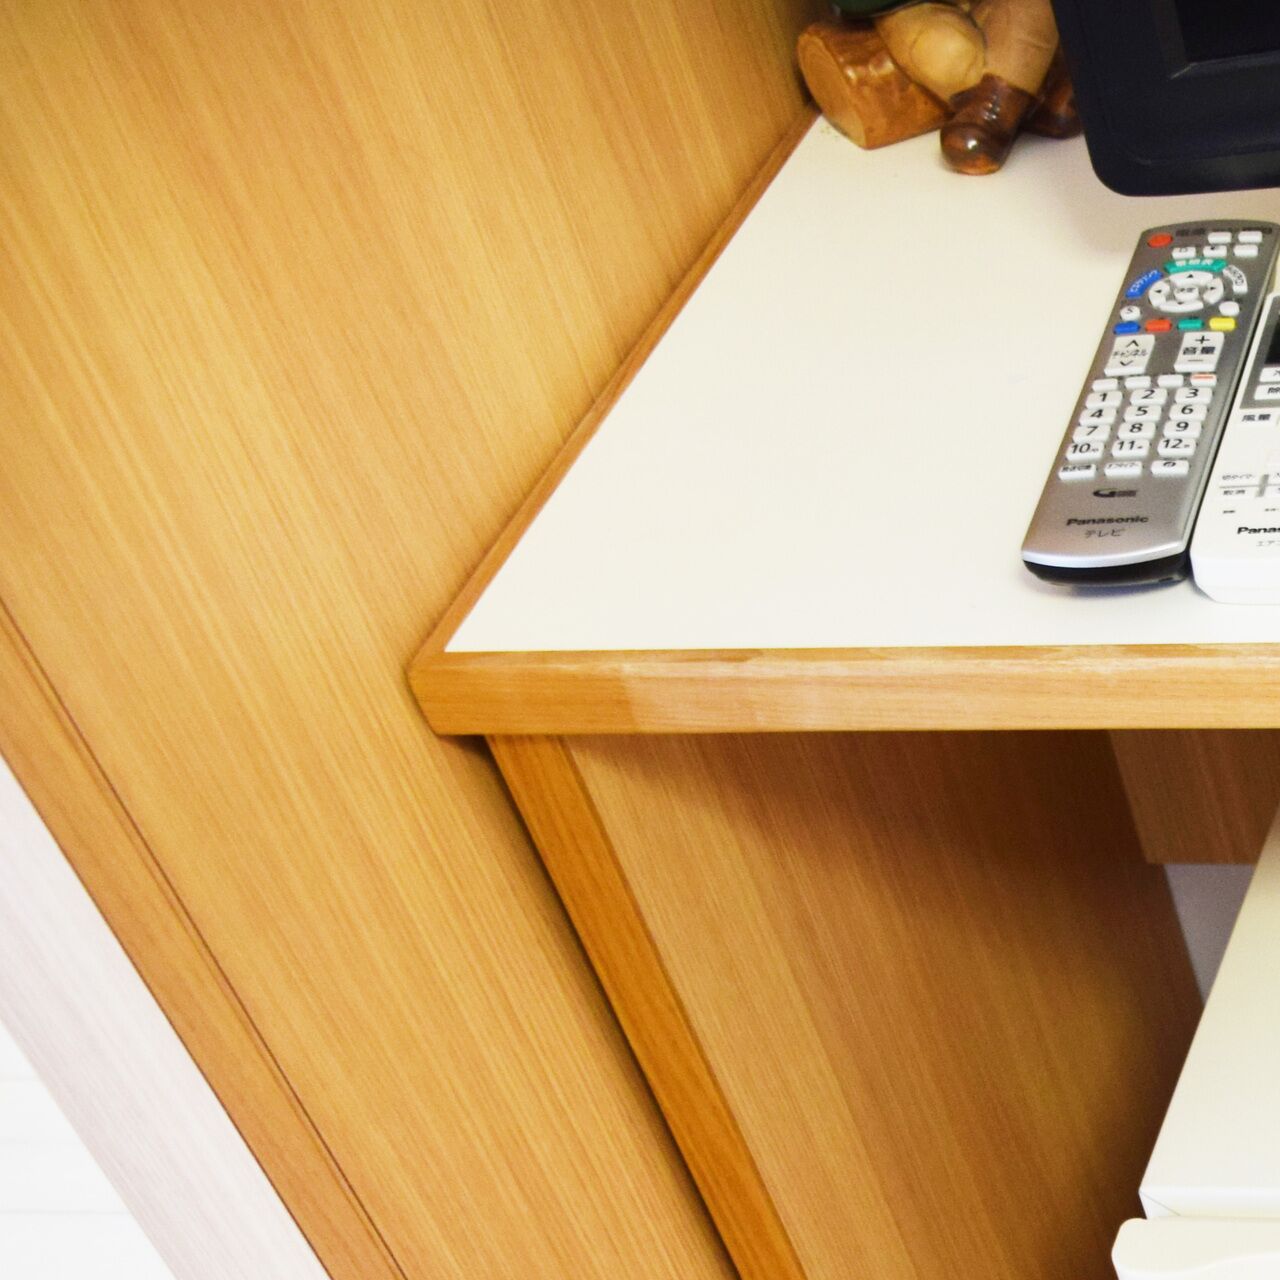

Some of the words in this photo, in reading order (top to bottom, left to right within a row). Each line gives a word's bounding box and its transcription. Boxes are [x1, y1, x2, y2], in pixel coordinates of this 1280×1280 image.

[1100, 392, 1107, 401] 1
[1141, 389, 1155, 399] 2
[1185, 388, 1198, 398] 3
[1090, 408, 1104, 418] 4
[1135, 406, 1149, 416] 5
[1181, 404, 1194, 414] 6
[1086, 425, 1098, 436] 7
[1129, 423, 1143, 433] 8
[1176, 421, 1189, 431] 9
[1066, 515, 1149, 526] Panasonic
[1084, 528, 1126, 539] テレビ
